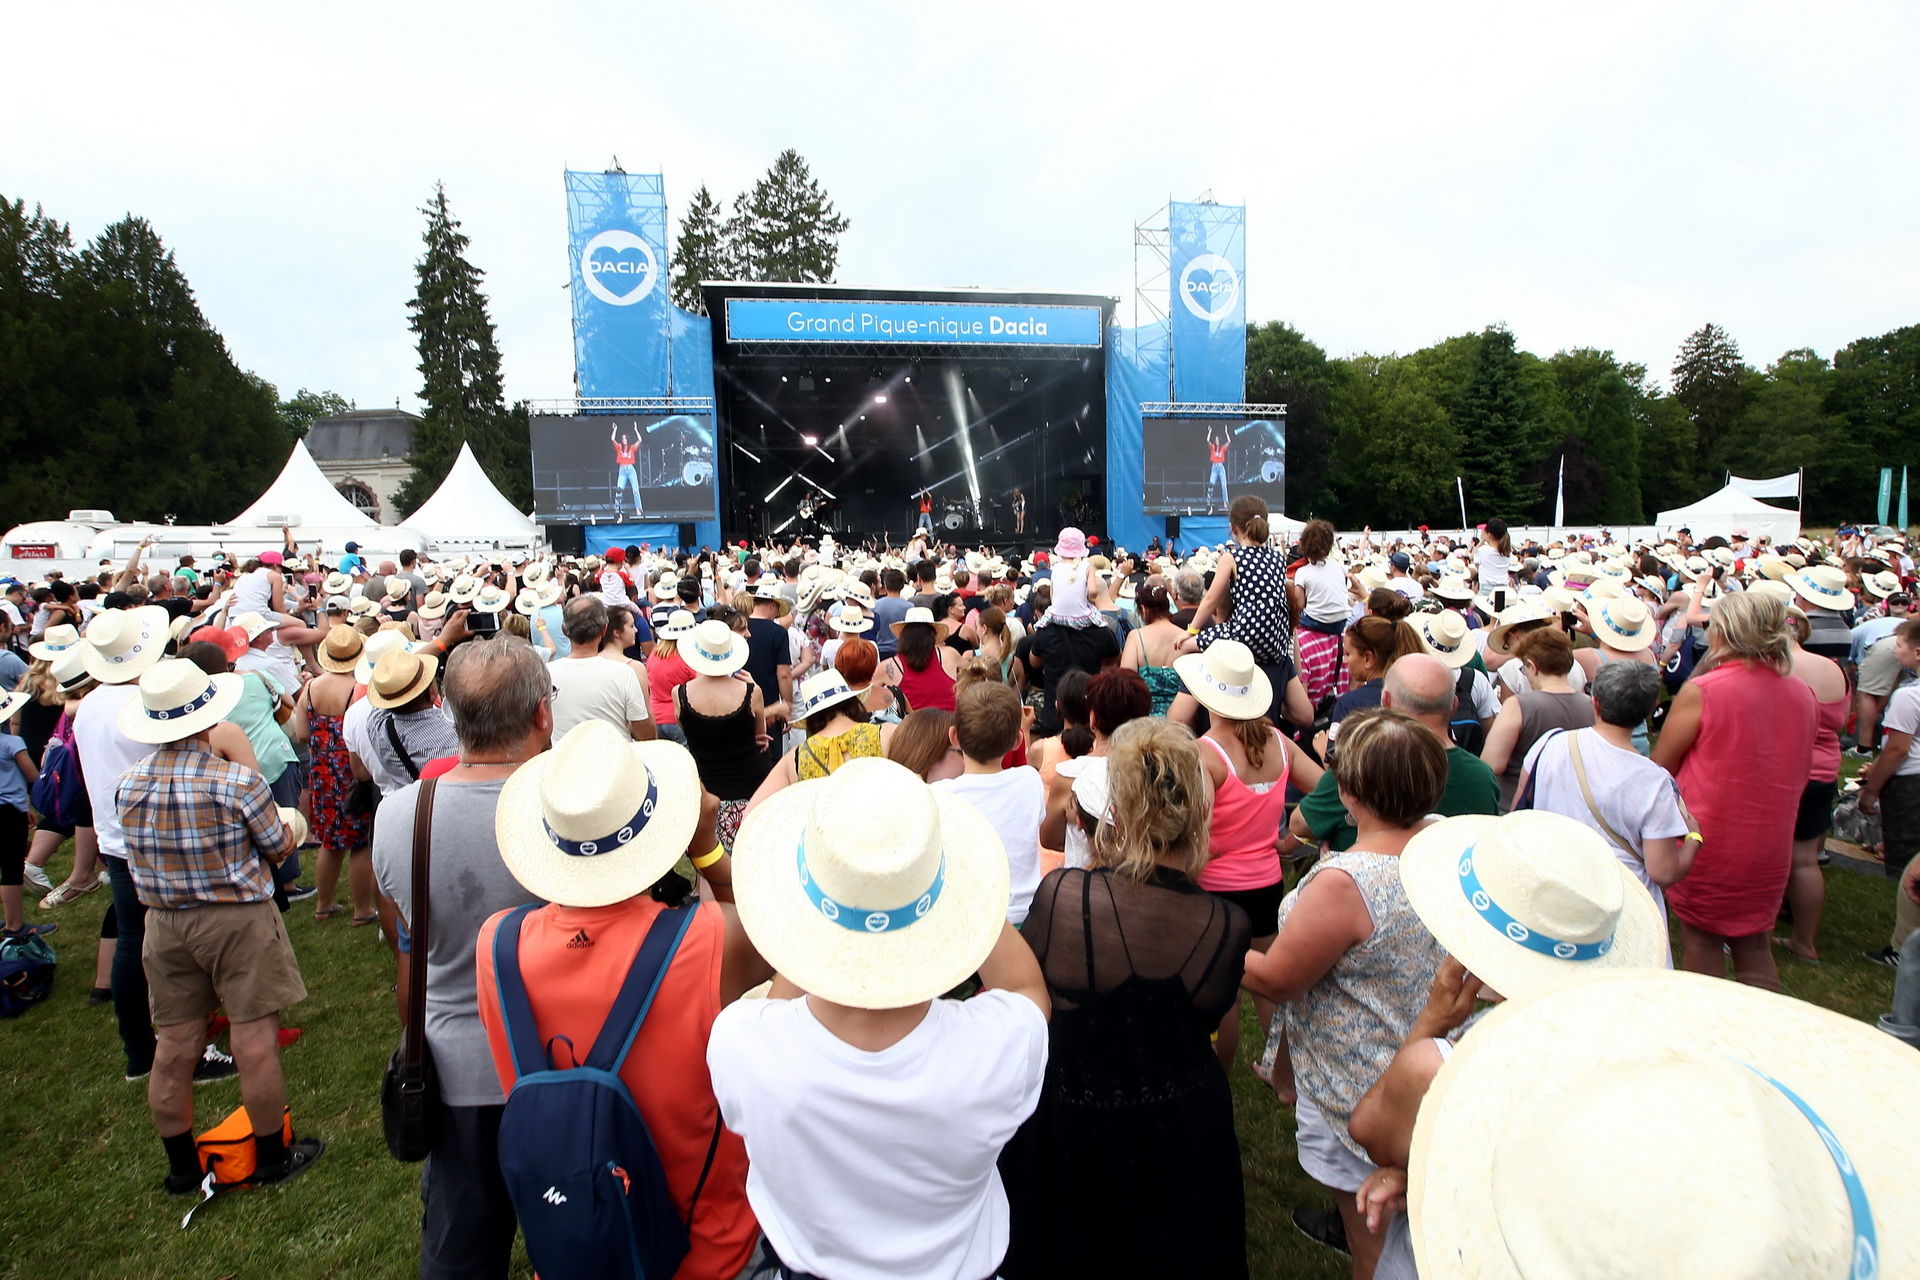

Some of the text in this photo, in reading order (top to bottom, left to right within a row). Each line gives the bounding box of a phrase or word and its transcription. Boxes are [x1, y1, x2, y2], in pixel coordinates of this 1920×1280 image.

[590, 261, 649, 274] DACIA
[1187, 281, 1234, 293] DACIA
[787, 311, 1048, 339] Grand Pique-nique Dacia
